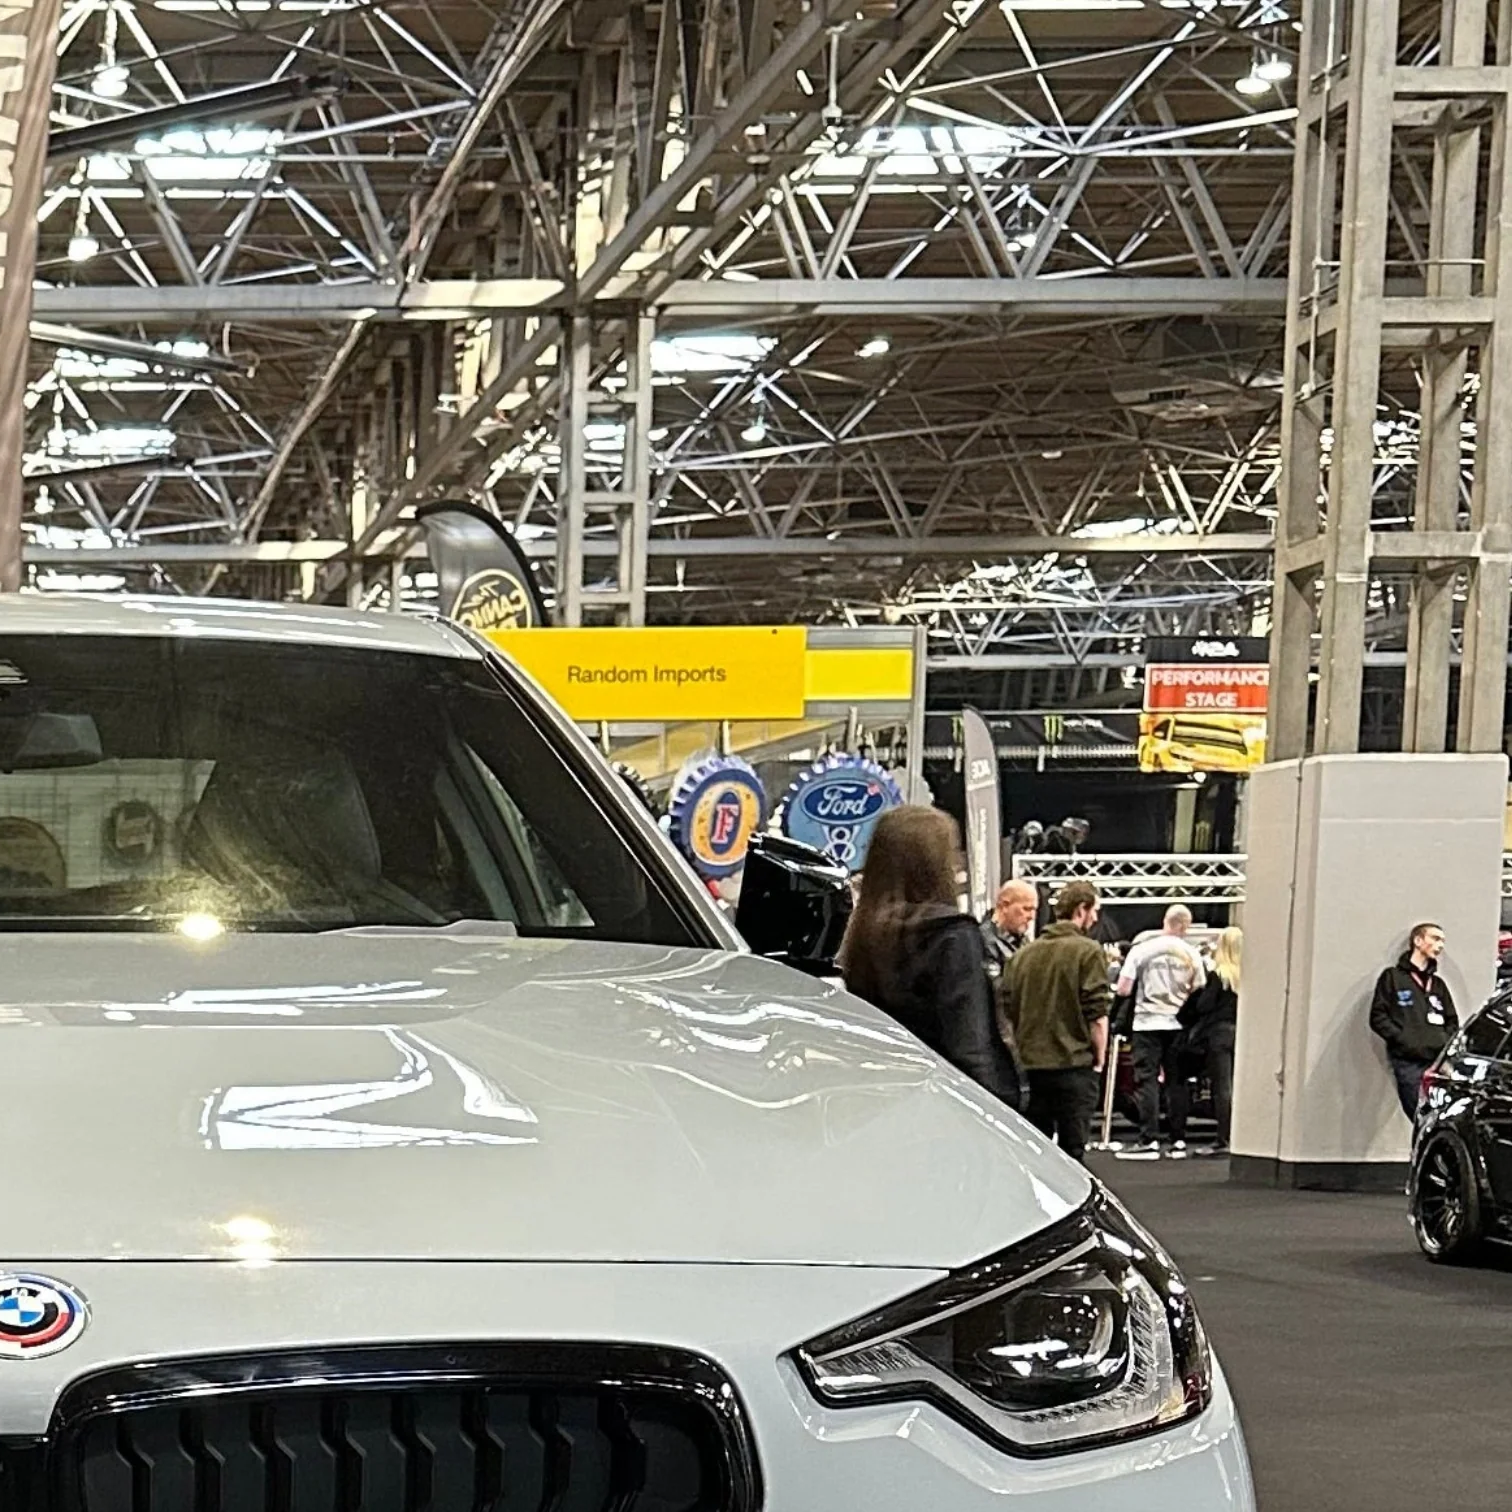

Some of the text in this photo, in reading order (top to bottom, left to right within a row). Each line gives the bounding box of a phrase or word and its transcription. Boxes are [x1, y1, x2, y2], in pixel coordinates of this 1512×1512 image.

[567, 665, 727, 686] Random Imports
[1185, 692, 1238, 707] STAGE
[817, 786, 869, 816] Ford
